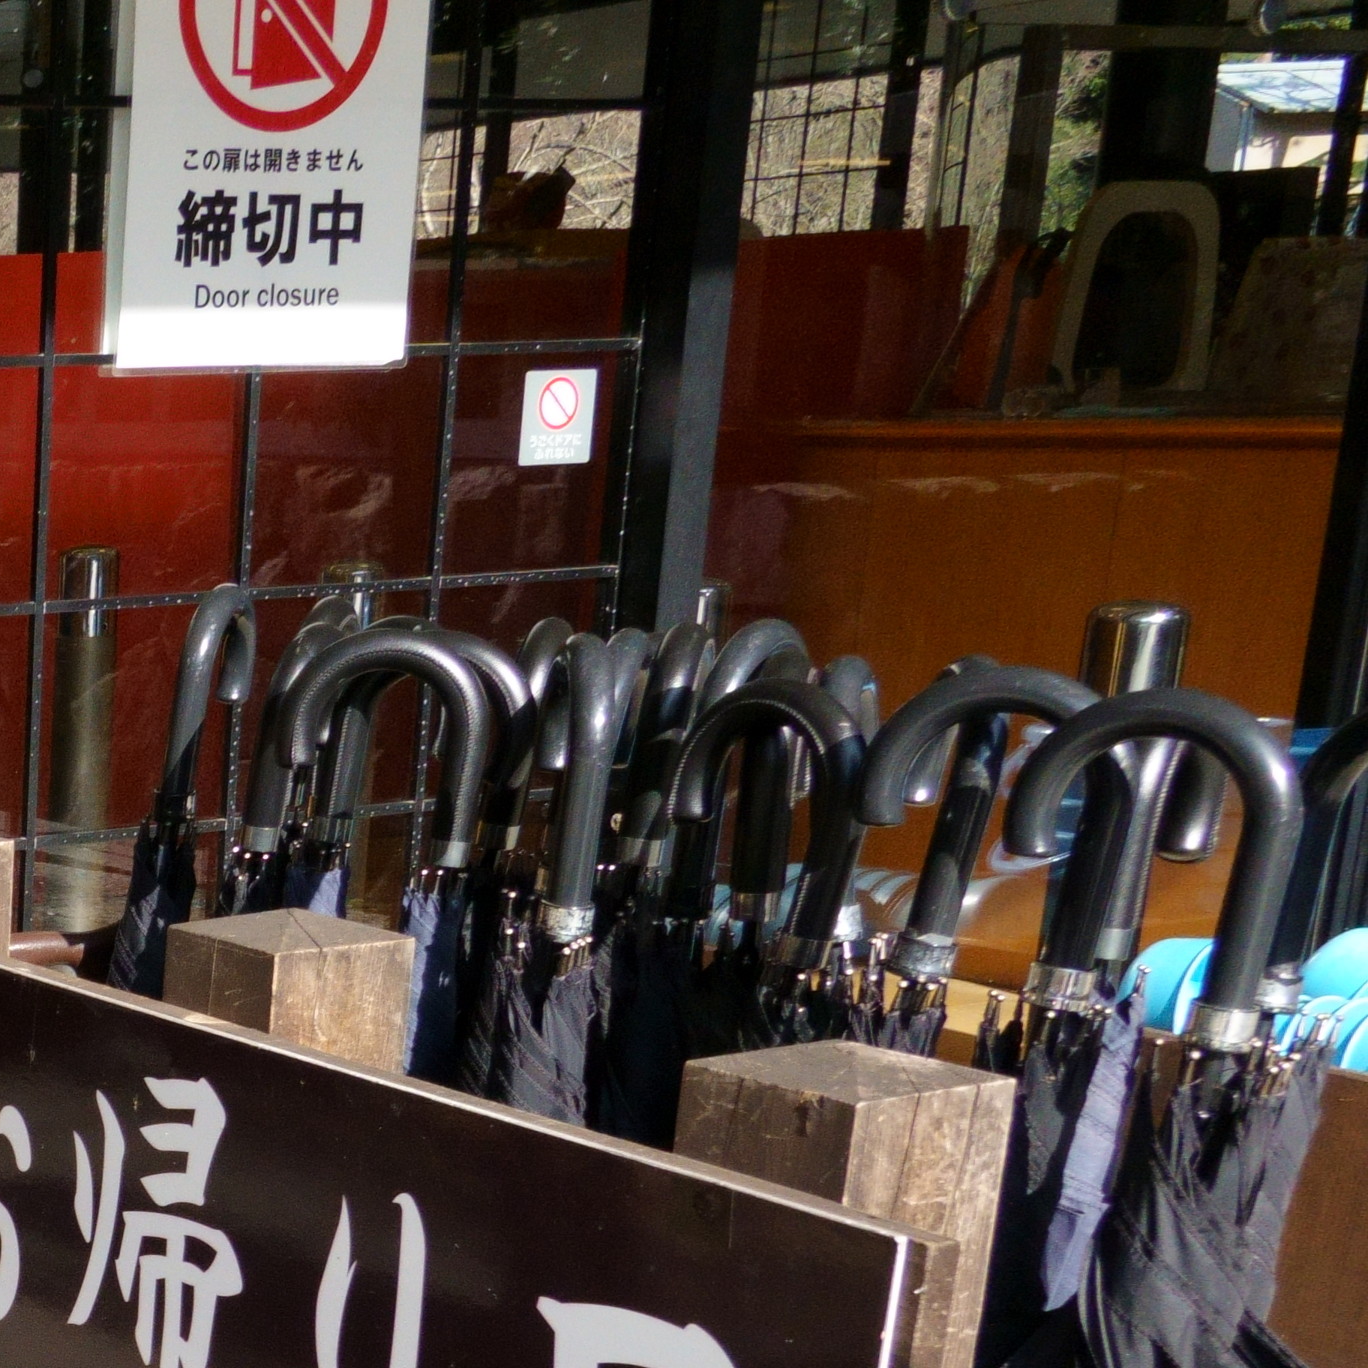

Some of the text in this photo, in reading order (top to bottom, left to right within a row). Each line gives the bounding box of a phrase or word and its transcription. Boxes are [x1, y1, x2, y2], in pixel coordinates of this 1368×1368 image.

[182, 147, 365, 174] この扉は開きません
[174, 188, 365, 269] 締切中
[194, 282, 341, 309] Door closure
